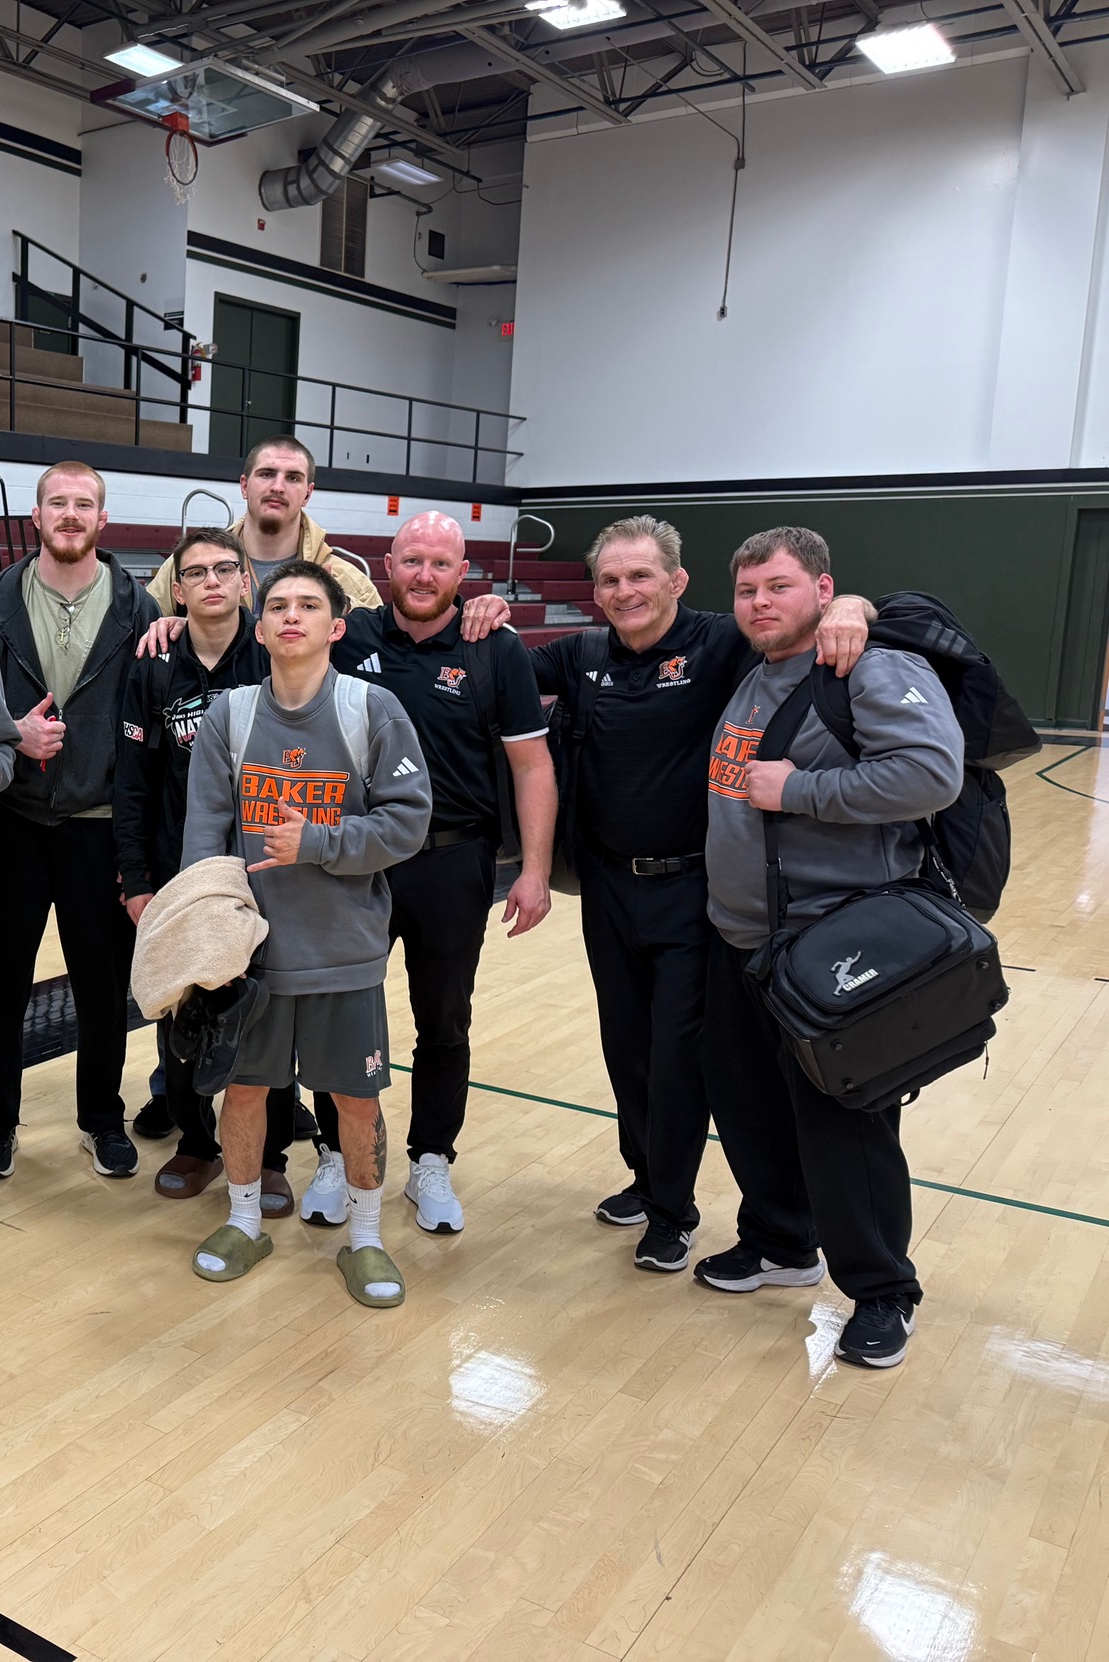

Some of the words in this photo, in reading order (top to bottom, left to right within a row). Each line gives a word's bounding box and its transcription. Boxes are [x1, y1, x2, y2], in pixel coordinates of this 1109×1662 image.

[187, 709, 204, 718] HIG
[242, 775, 346, 804] BAKER
[242, 800, 342, 827] WRELING
[842, 968, 879, 992] CRAMER
